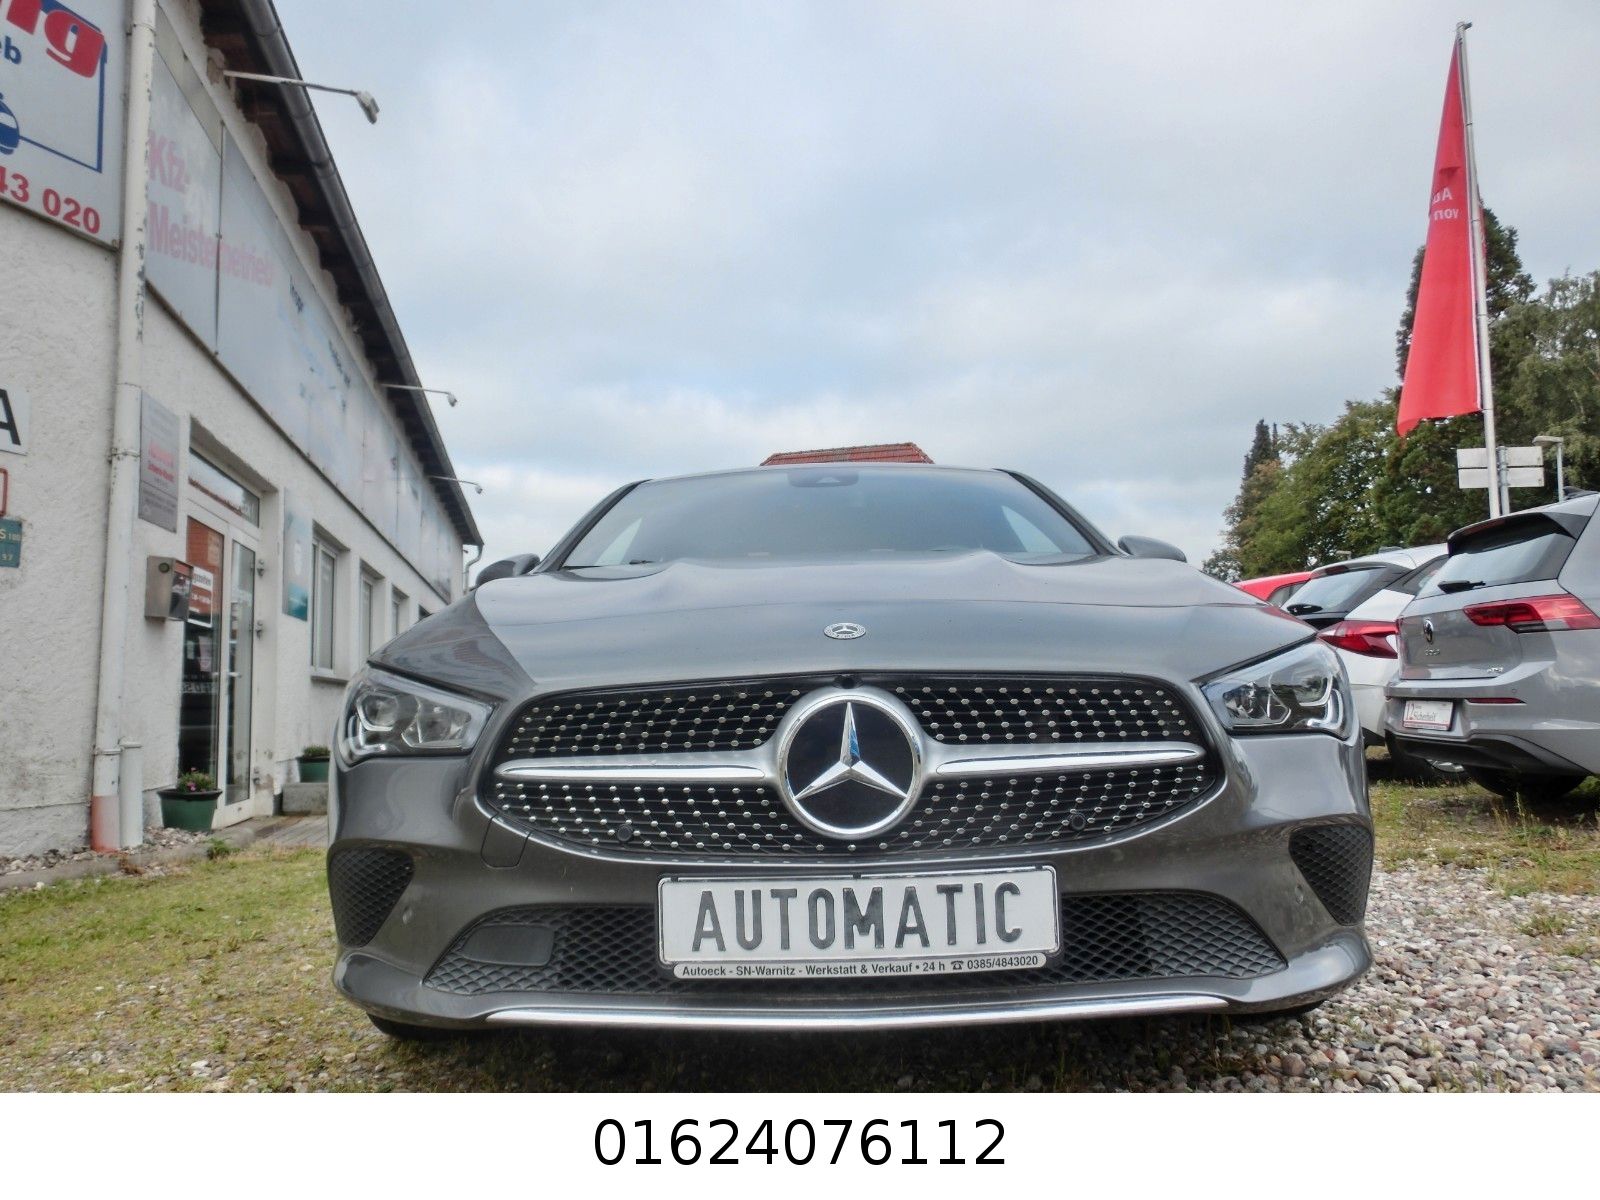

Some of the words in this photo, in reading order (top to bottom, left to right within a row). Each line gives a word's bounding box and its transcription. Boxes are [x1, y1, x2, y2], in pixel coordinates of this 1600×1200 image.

[43, 188, 100, 234] 020
[691, 881, 1023, 952] AUTOMATIC
[682, 965, 726, 976] Autoeck
[736, 965, 796, 976] SN-Warnitz
[805, 964, 857, 975] Werkstatt
[860, 964, 868, 974] &
[871, 962, 912, 974] Verkauf
[922, 961, 935, 972] 24
[938, 961, 945, 971] h
[967, 955, 1038, 970] 0385/4843020
